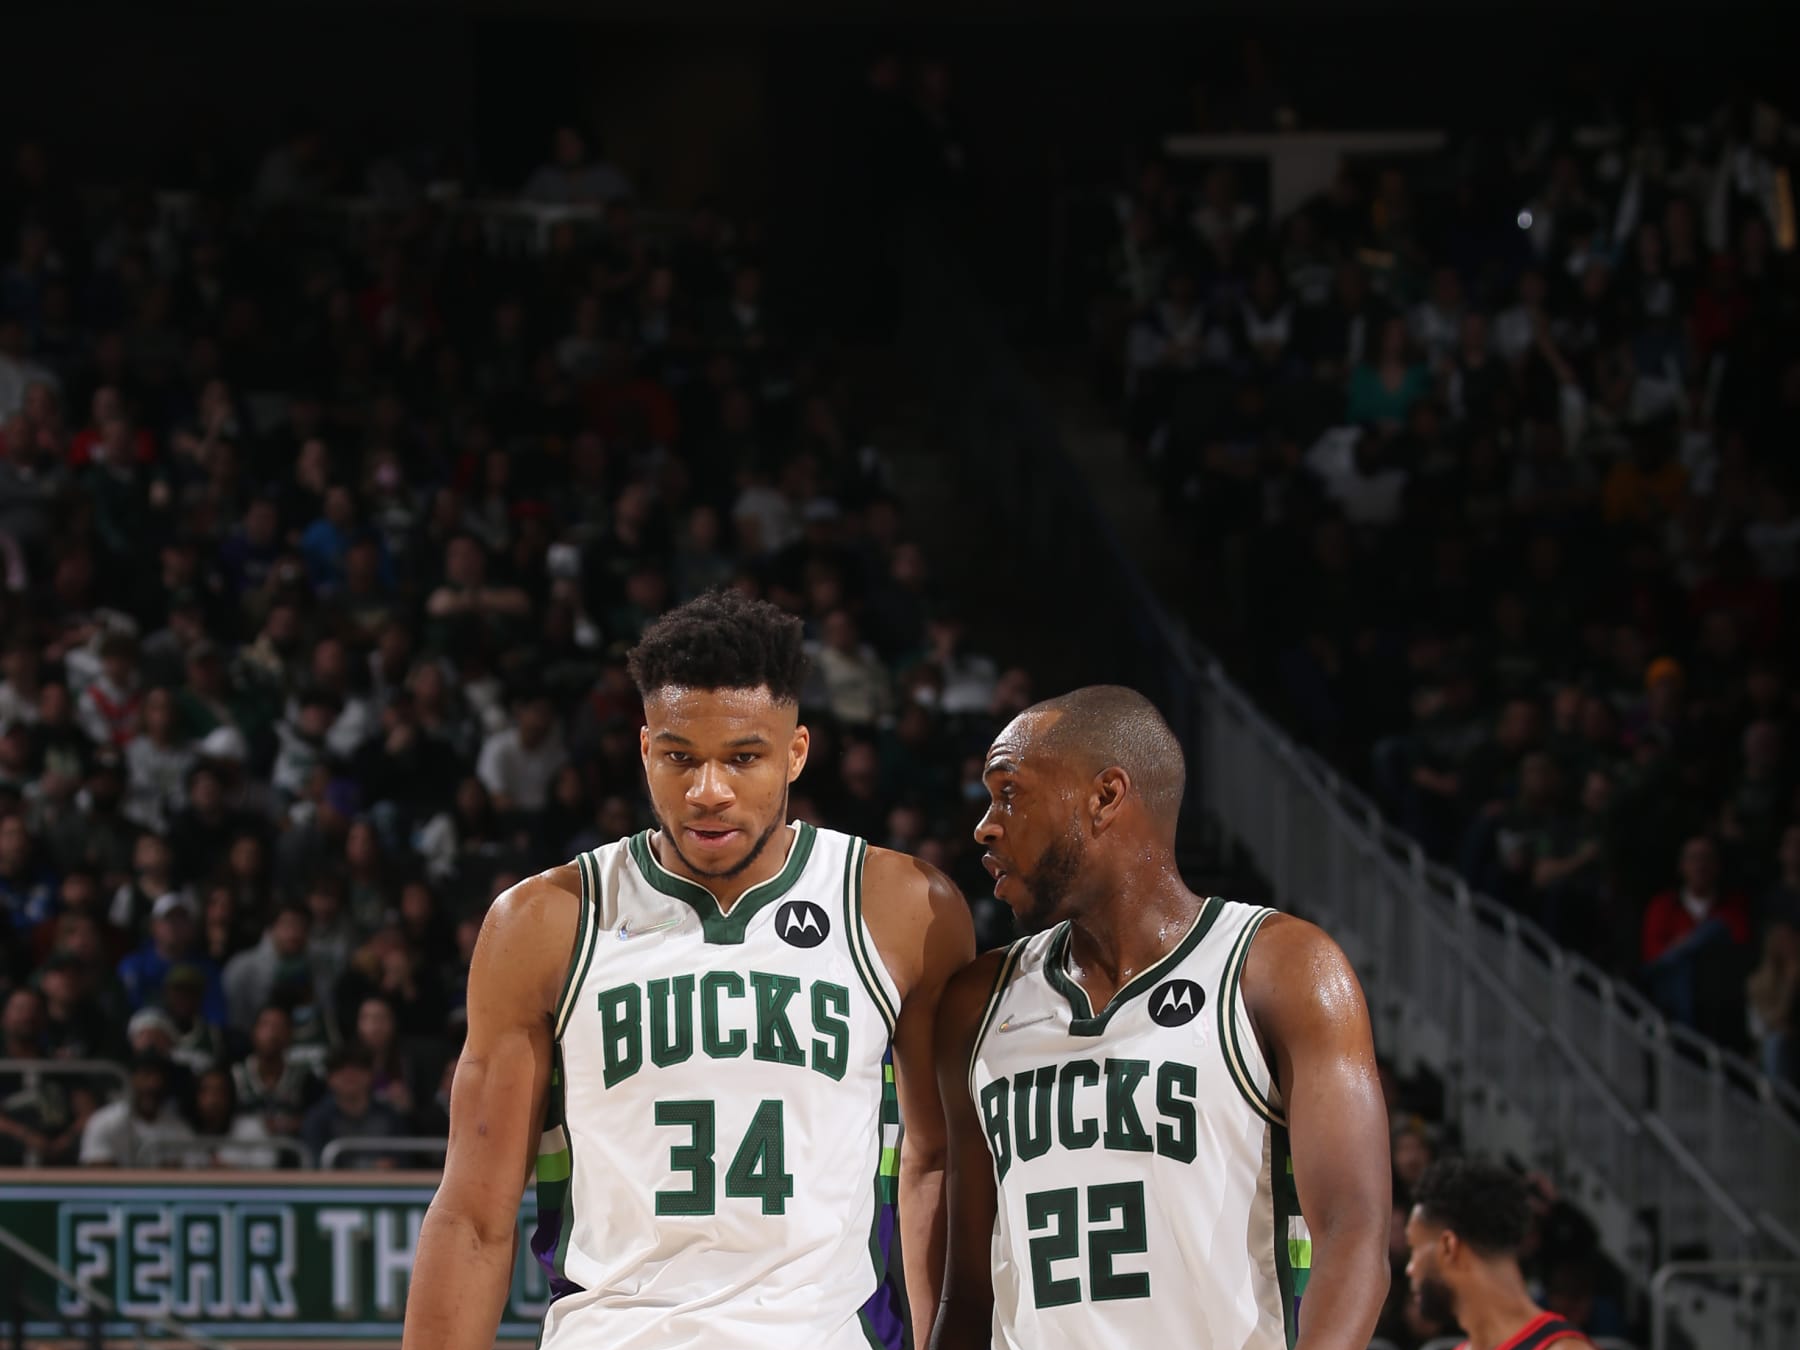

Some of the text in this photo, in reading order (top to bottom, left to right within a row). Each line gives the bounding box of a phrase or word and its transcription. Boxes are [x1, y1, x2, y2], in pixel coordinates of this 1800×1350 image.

[598, 971, 850, 1089] BUCKS
[654, 1099, 794, 1216] 34
[980, 1059, 1198, 1187] BUCKS
[57, 1202, 297, 1318] FEAR
[316, 1208, 422, 1310] TH
[1026, 1180, 1151, 1309] 22
